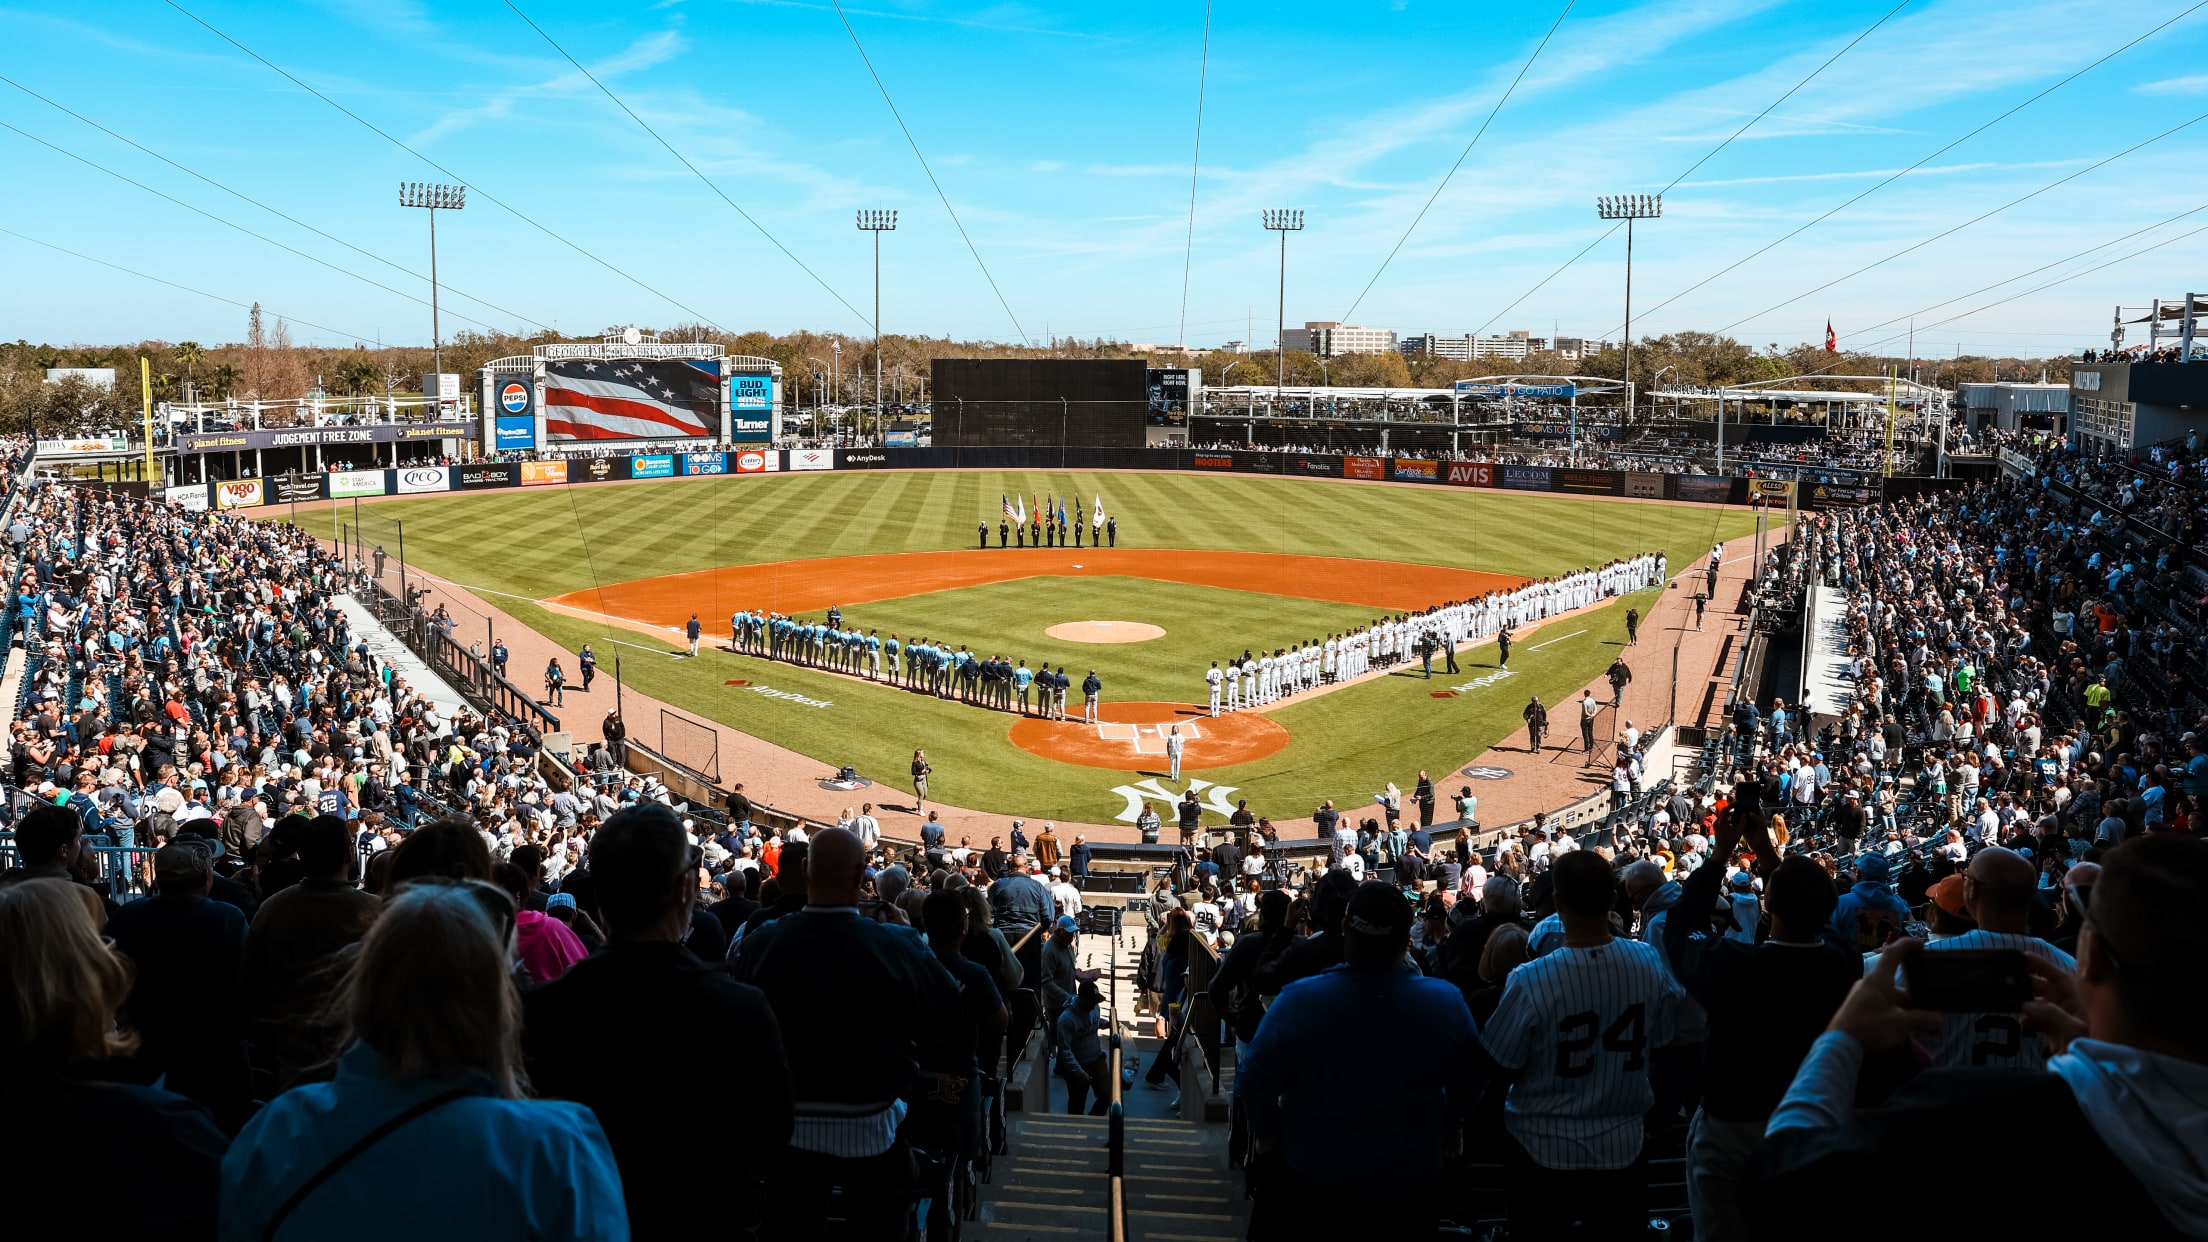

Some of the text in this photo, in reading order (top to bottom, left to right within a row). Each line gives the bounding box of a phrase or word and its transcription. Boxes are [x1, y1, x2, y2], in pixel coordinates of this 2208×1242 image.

[740, 380, 763, 389] BUD
[735, 388, 767, 398] LIGHT
[1465, 385, 1500, 394] ROOMS
[1518, 386, 1534, 395] GO
[1537, 386, 1563, 396] PATIO
[734, 418, 769, 430] Turner
[1522, 424, 1552, 434] ROOMS
[1554, 426, 1565, 434] TO
[406, 427, 464, 438] planet fitness
[194, 436, 247, 450] planet fitness
[272, 430, 373, 446] JUDGEMENT FREE ZONE
[688, 453, 722, 462] ROOMS
[1195, 458, 1232, 467] HOOTERS
[688, 465, 718, 474] TO GO
[1306, 462, 1330, 471] Fanatics
[411, 472, 435, 482] PCC
[1448, 466, 1489, 483] AVIS
[1564, 474, 1588, 482] WELLS
[1870, 490, 1881, 498] 314
[745, 686, 835, 708] AnyDesk
[2042, 763, 2056, 775] 99
[320, 800, 338, 812] 42
[1354, 862, 1360, 872] 2
[1554, 1002, 1648, 1079] 24
